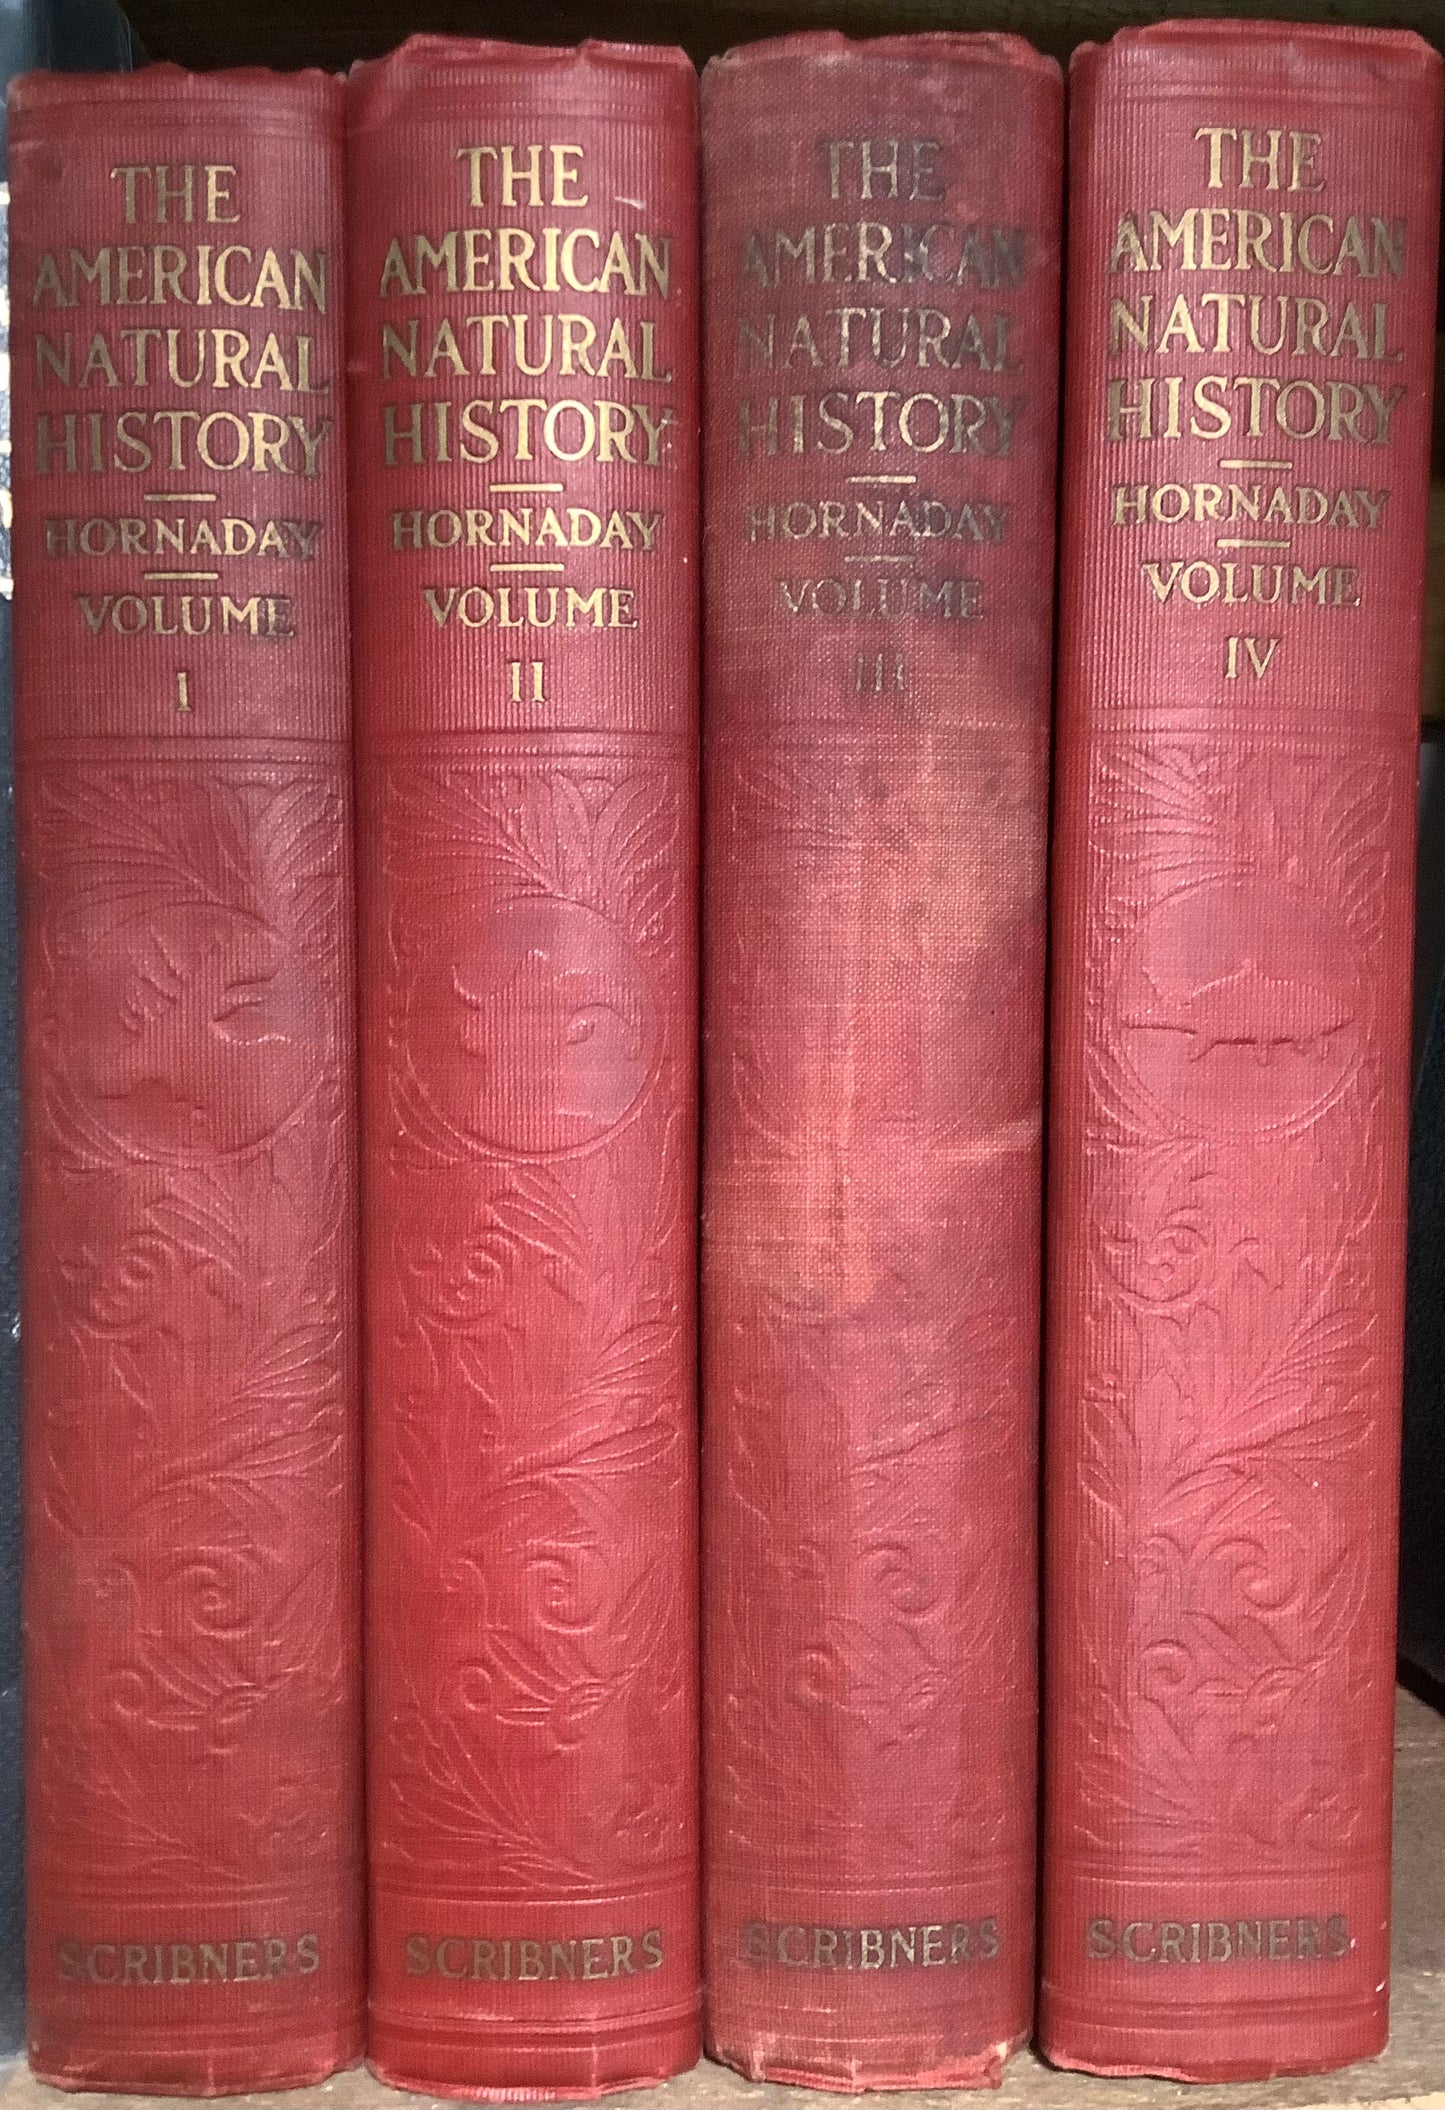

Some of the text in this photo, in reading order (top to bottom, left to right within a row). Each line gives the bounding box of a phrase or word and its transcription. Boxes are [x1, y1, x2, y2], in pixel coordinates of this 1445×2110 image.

[456, 144, 589, 207] THE
[820, 139, 944, 200] THE
[1194, 127, 1325, 192] THE
[110, 164, 241, 224] THE
[379, 227, 672, 300] AMERICAN
[743, 220, 1027, 289] AMERICAN
[1110, 207, 1406, 278] AMERICAN
[33, 245, 327, 314] AMERICAN
[382, 313, 673, 383] NATURAL
[738, 307, 1023, 375] NATURAL
[1110, 293, 1404, 362] NATURAL
[35, 327, 330, 394] NATURAL
[383, 397, 676, 466] HISTORY
[738, 390, 1023, 457] HISTORY
[1107, 375, 1406, 444] HISTORY
[36, 410, 333, 476] HISTORY
[391, 507, 662, 550] HORNADAY
[748, 500, 1009, 542] HORNADAY
[1112, 483, 1389, 528] HORNADAY
[46, 517, 322, 560] HORNADAY
[423, 586, 638, 628] VOLUME
[779, 578, 984, 620] VOLUME
[1142, 561, 1361, 607] VOLUME
[75, 594, 294, 637] VOLUME
[508, 661, 546, 703] II
[855, 652, 906, 692] III
[1224, 636, 1280, 679] IV
[175, 671, 192, 712] I
[57, 1932, 320, 1985] SCRIBNERS
[405, 1929, 664, 1982] SCRIBNERS
[743, 1918, 998, 1971] SCRIBNERS
[1086, 1915, 1351, 1963] SCRIBNERS
